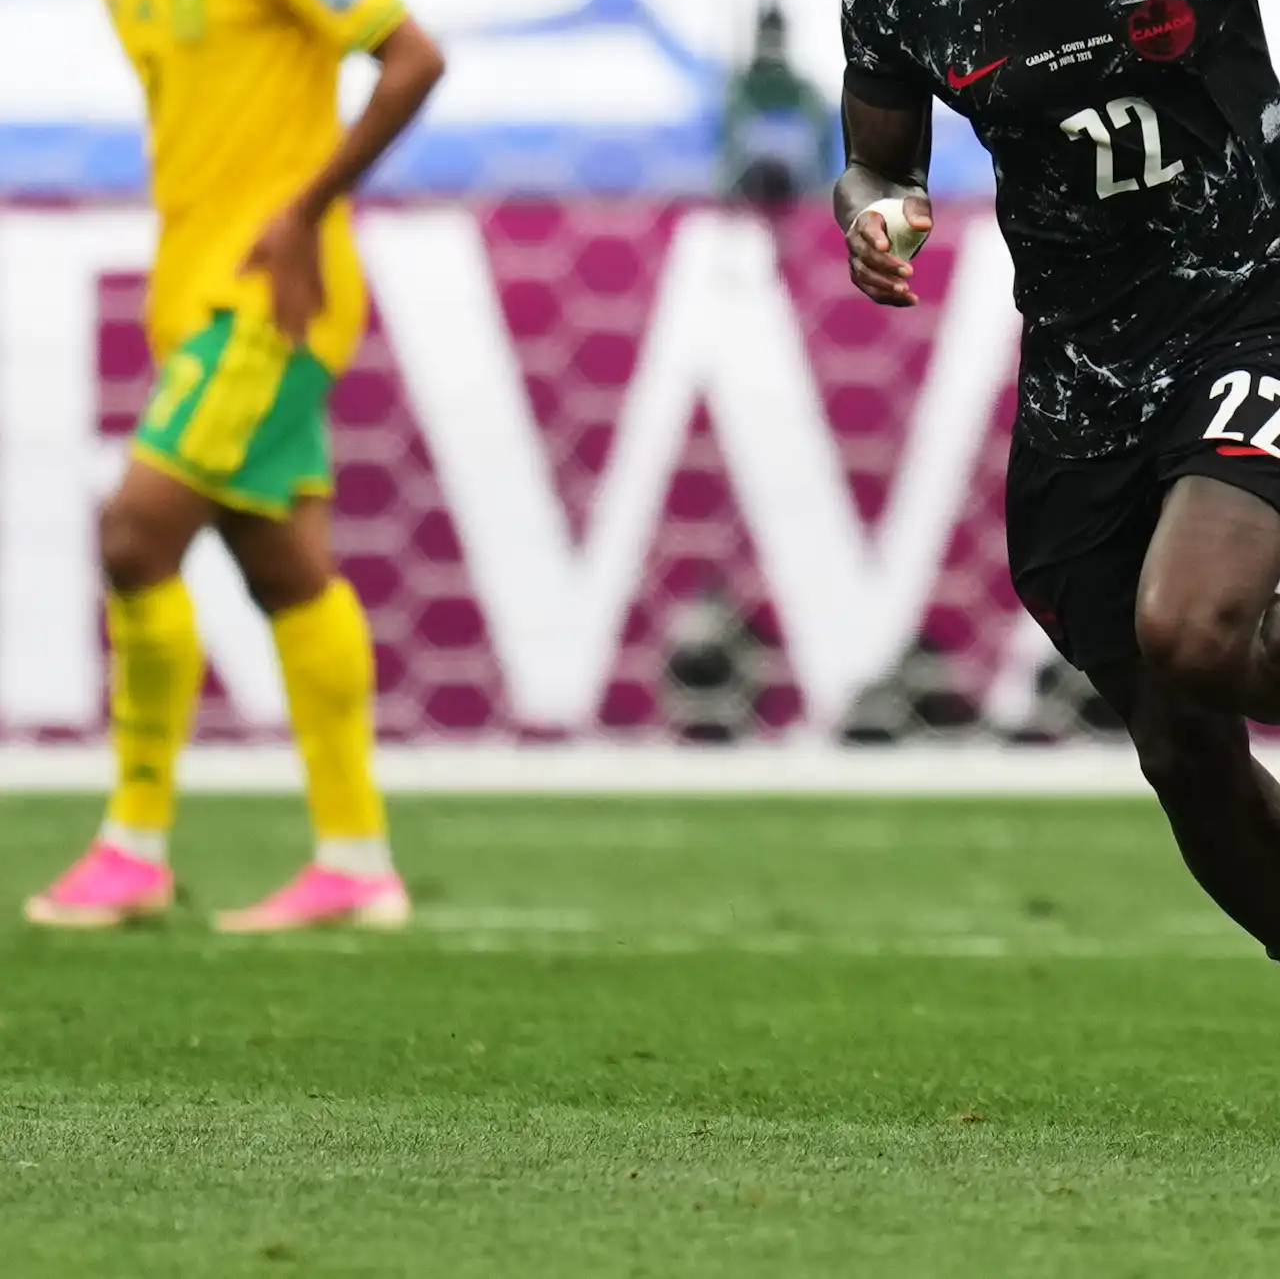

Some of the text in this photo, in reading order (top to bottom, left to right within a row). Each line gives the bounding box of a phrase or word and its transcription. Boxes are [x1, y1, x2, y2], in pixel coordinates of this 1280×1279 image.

[1131, 16, 1194, 41] CANADA
[1025, 49, 1055, 67] CANADA
[1061, 40, 1086, 54] SOUTH
[1087, 33, 1114, 48] AFRICA
[1059, 54, 1076, 67] JUNE
[1059, 96, 1185, 200] 22
